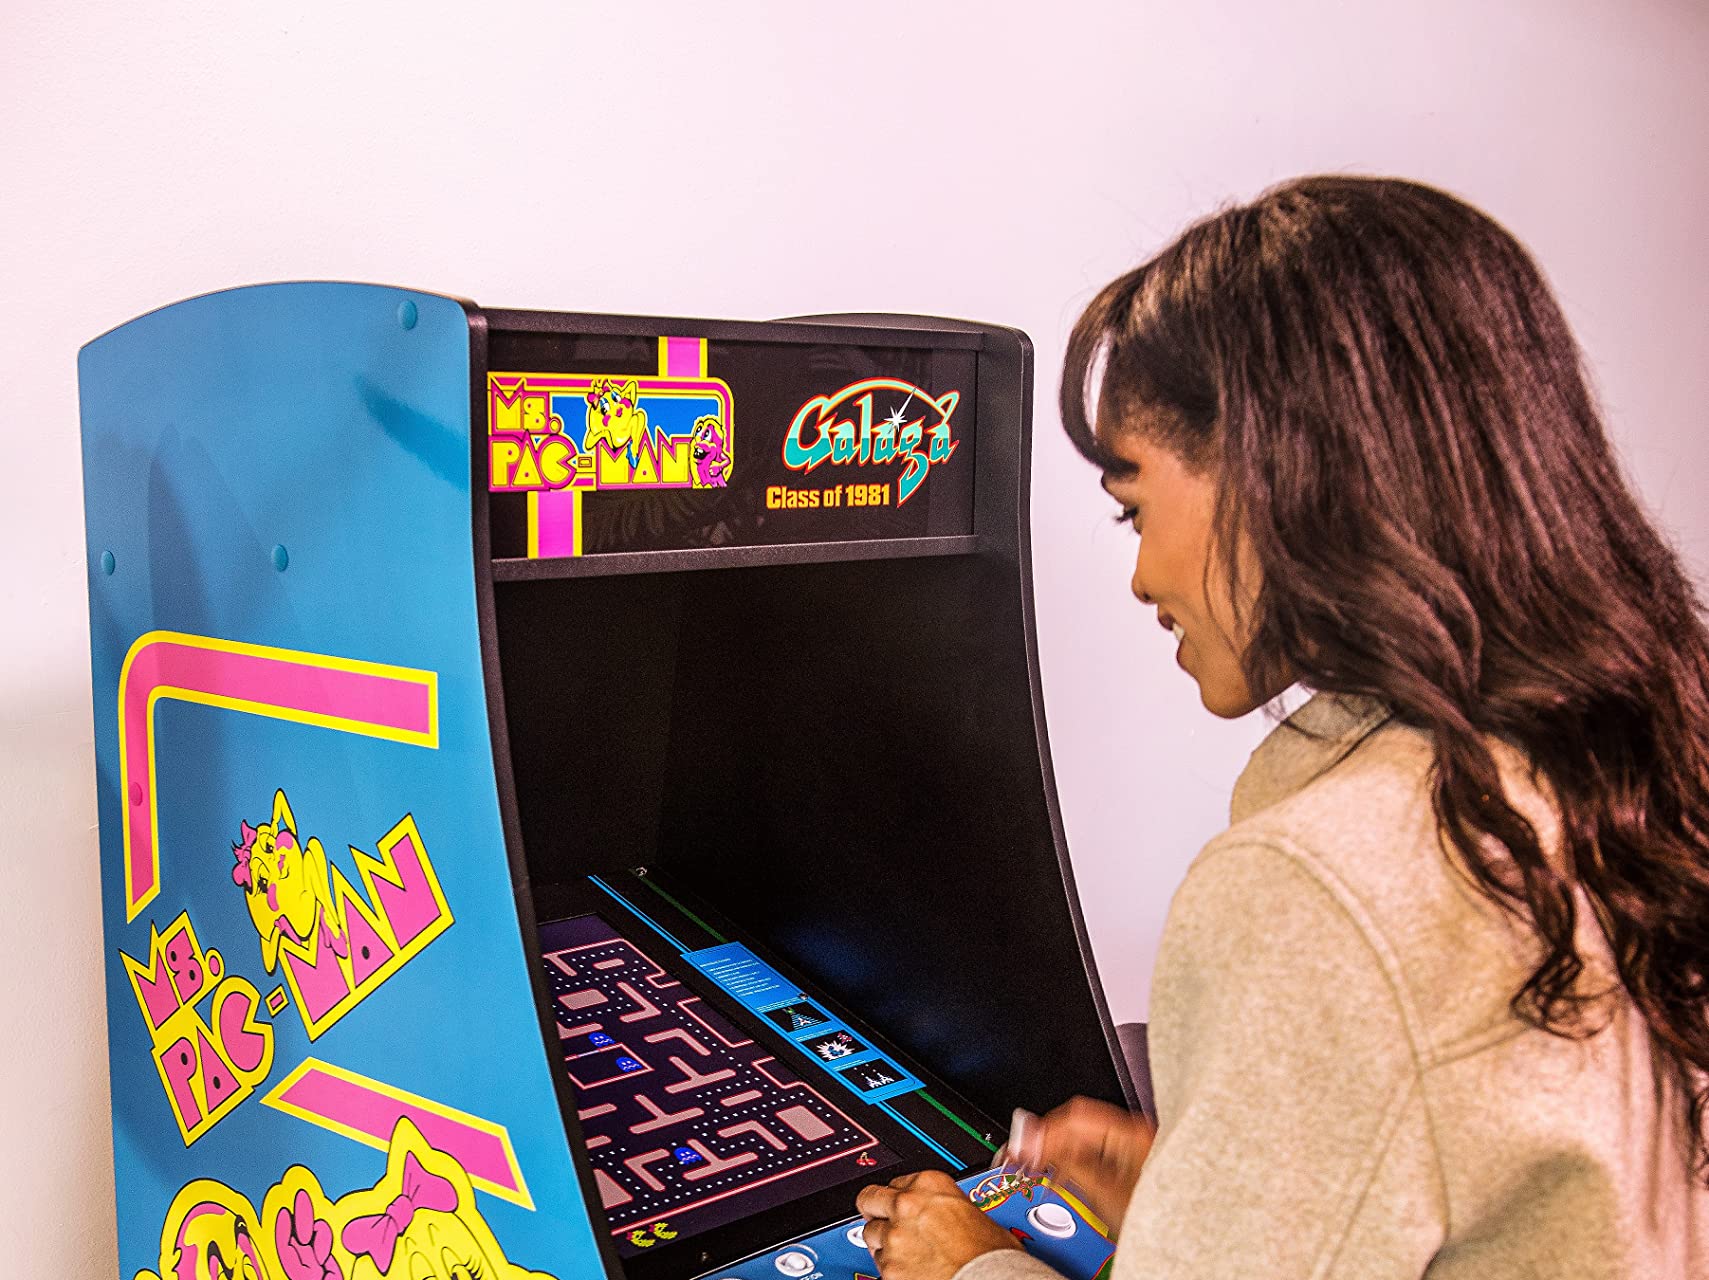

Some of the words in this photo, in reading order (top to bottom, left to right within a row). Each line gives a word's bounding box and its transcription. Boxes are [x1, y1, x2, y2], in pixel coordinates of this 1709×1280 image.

[488, 428, 694, 491] PAC-MAN
[783, 377, 961, 508] Galaga
[766, 485, 818, 510] Class
[823, 484, 843, 507] of
[845, 483, 891, 507] 1981
